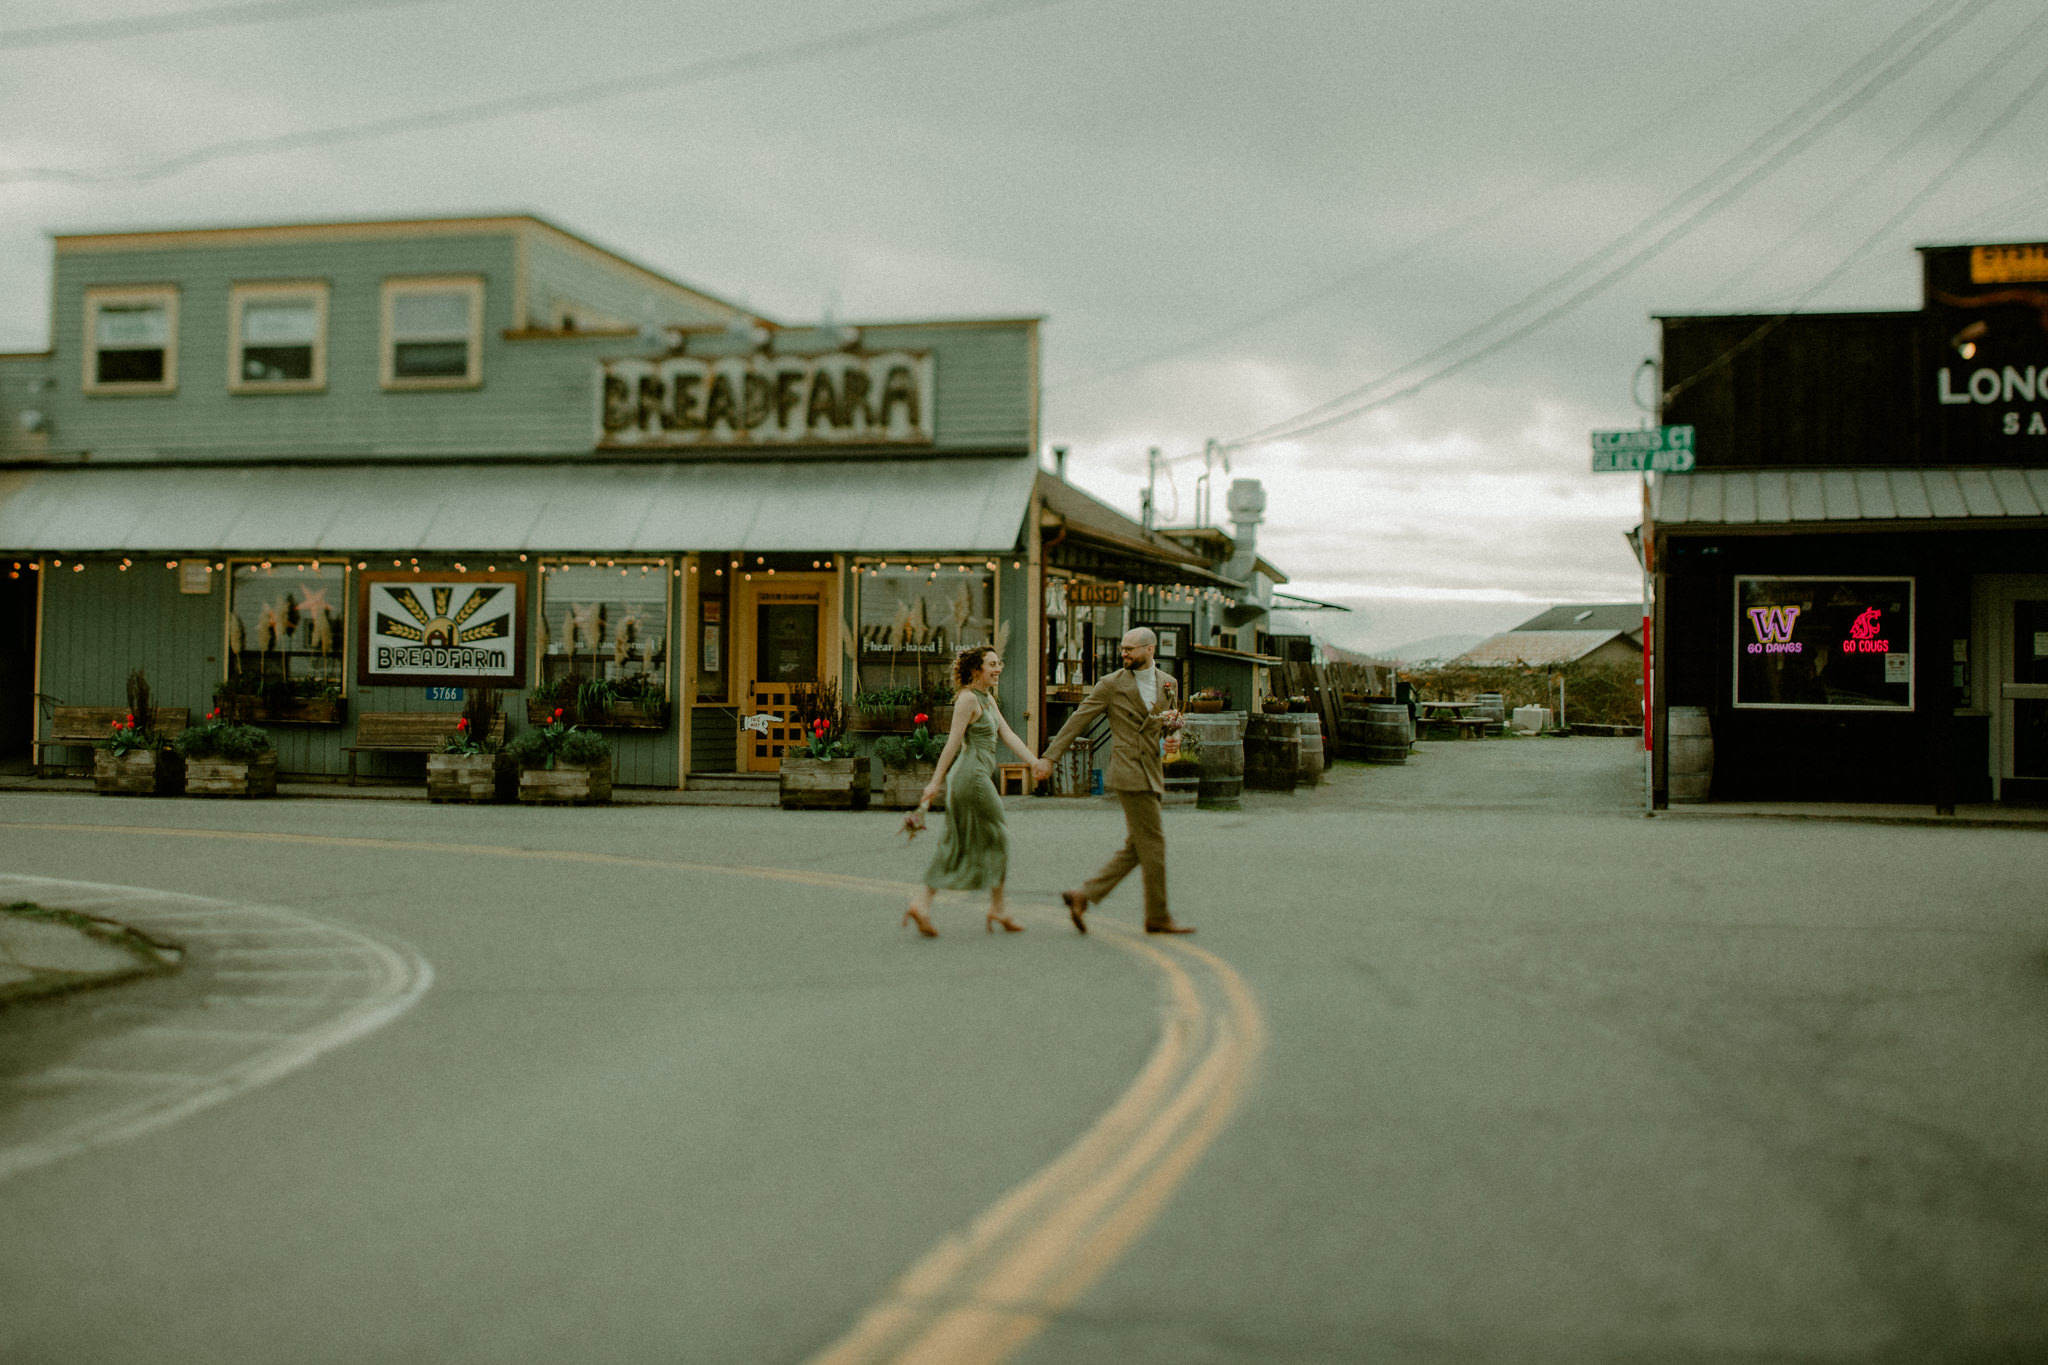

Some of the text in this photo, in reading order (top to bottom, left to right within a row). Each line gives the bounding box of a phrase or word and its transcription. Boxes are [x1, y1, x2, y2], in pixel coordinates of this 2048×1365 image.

[1067, 584, 1119, 604] CLOSED
[1747, 642, 1802, 653] GO DAWGS
[1843, 640, 1889, 652] GO COUGS
[377, 646, 506, 669] BREADFARM
[432, 687, 457, 700] 5766
